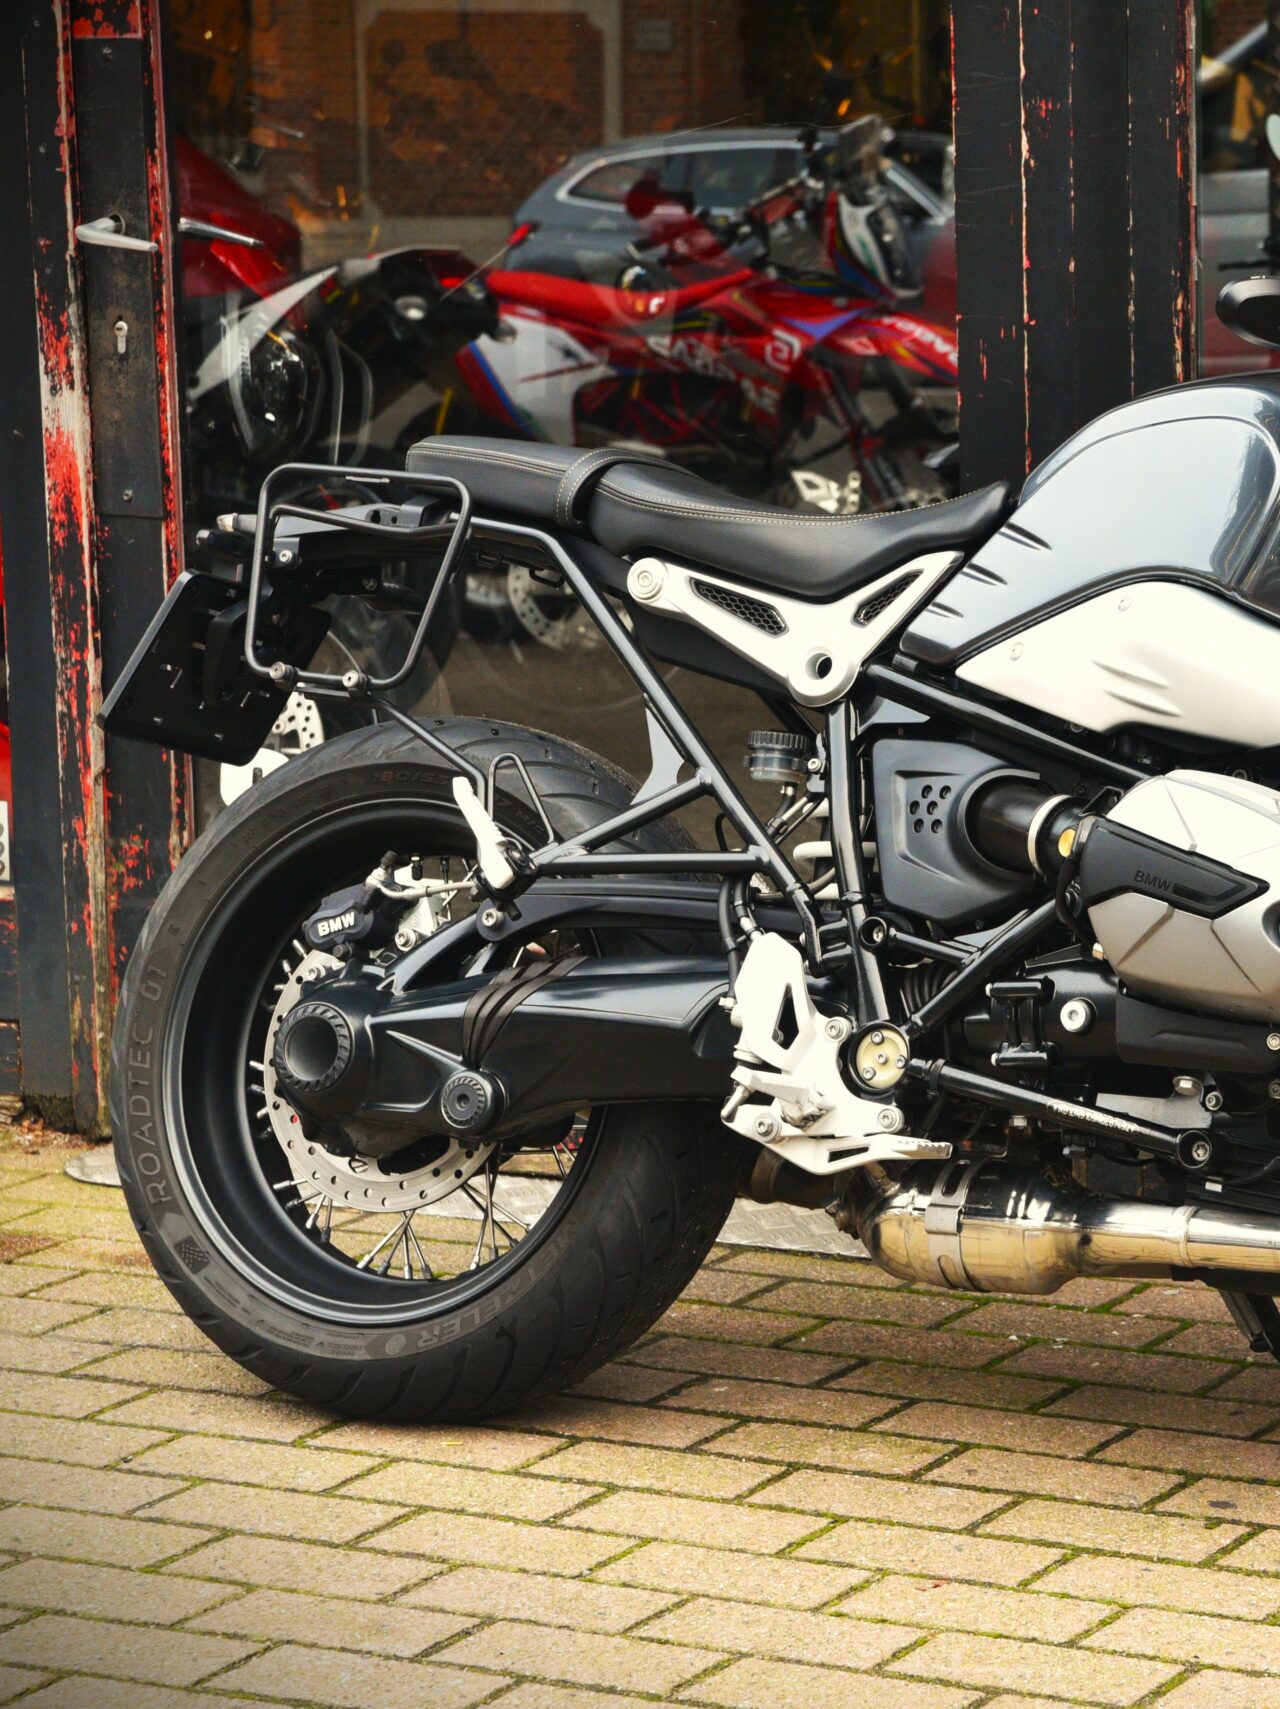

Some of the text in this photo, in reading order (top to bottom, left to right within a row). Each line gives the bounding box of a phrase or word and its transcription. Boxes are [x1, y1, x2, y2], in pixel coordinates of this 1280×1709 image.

[1133, 869, 1172, 892] BMW
[317, 911, 355, 937] BMW
[129, 1026, 172, 1204] ROADTEC
[418, 1228, 571, 1347] METZELER
